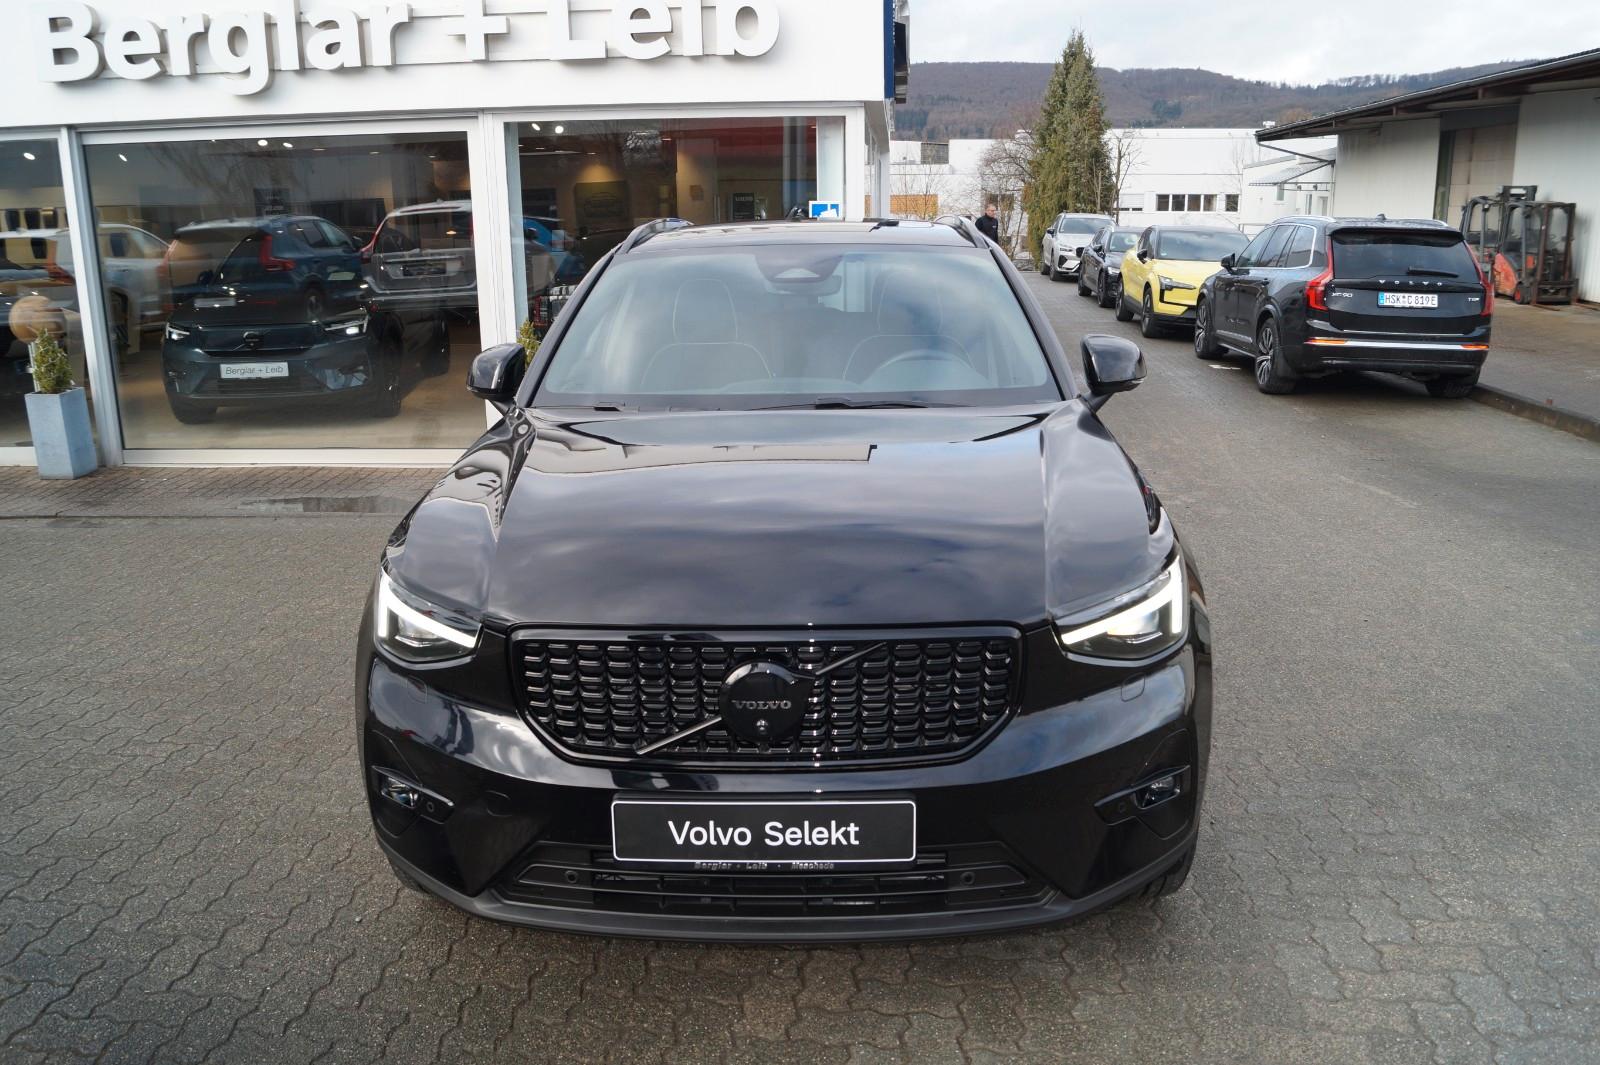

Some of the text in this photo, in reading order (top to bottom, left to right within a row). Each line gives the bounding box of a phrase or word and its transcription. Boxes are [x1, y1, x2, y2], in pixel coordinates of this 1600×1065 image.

[35, 0, 780, 96] Berglar + Leib
[1385, 294, 1401, 304] HSK
[225, 366, 256, 376] Berglar
[265, 365, 284, 374] Leib
[731, 700, 792, 710] VOLVO
[667, 820, 860, 846] Volvo Selekt
